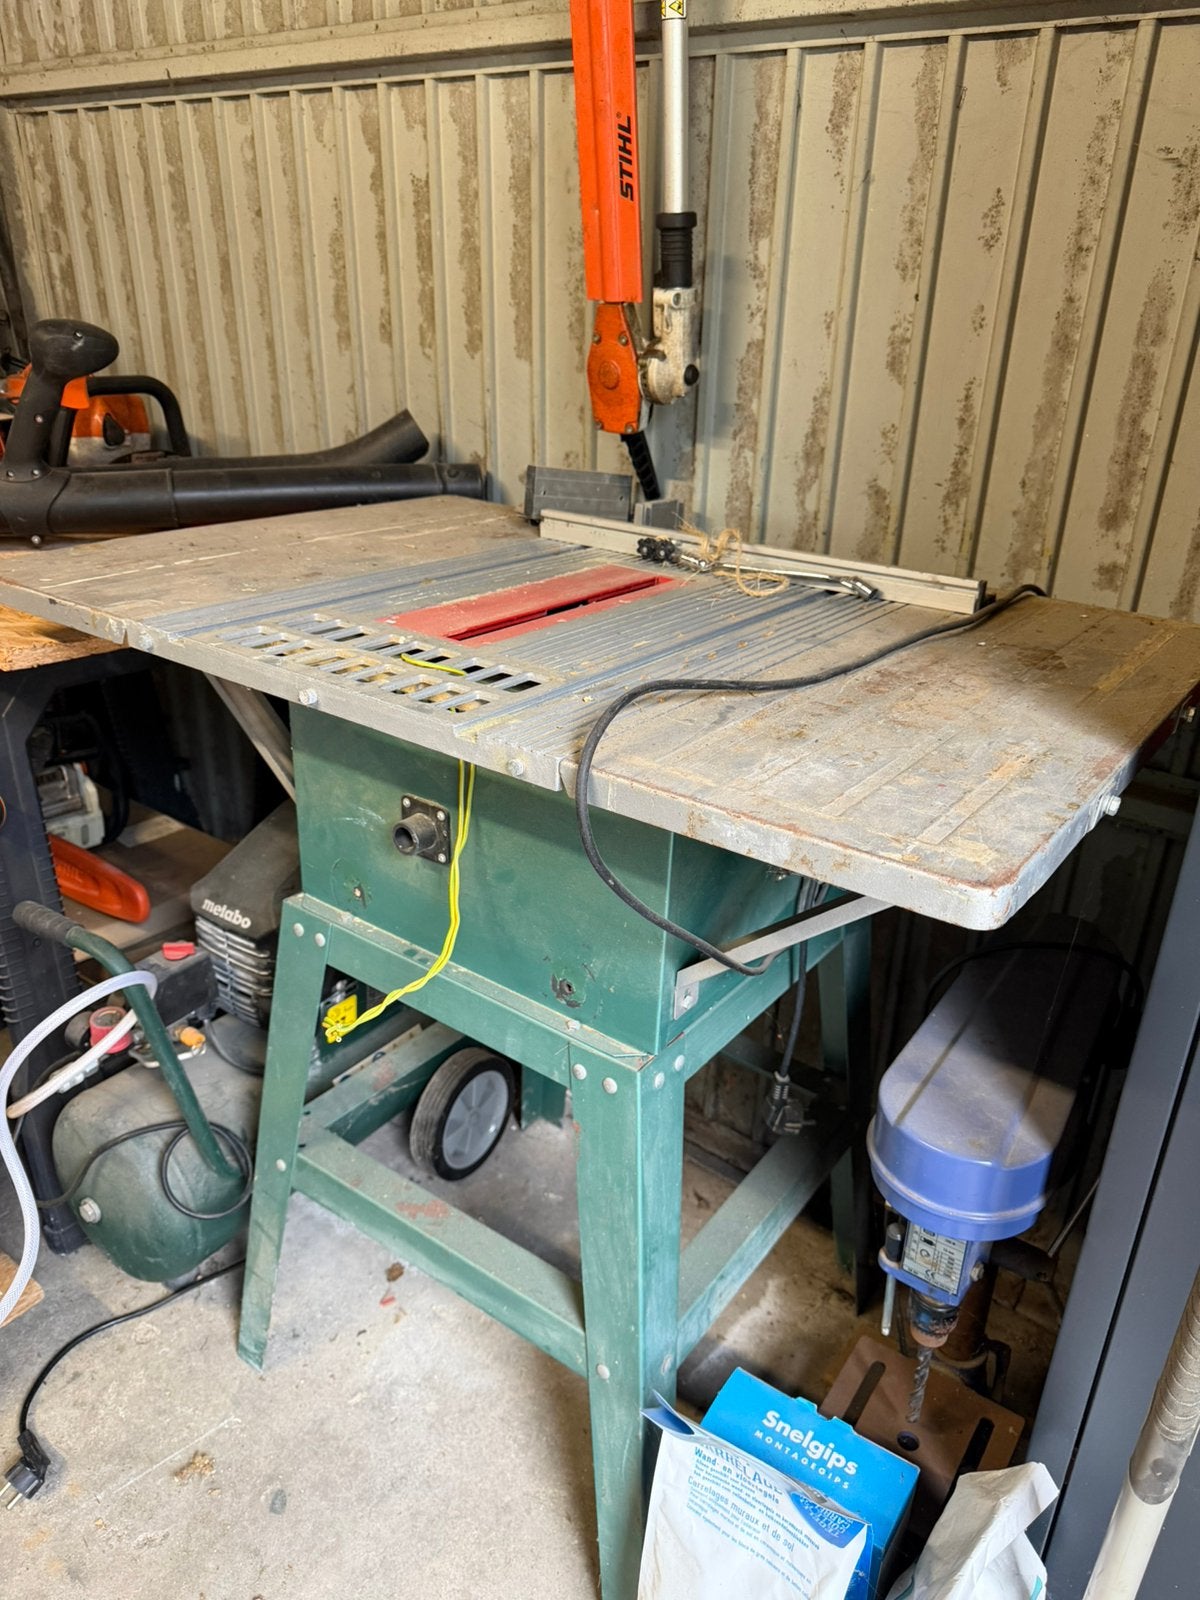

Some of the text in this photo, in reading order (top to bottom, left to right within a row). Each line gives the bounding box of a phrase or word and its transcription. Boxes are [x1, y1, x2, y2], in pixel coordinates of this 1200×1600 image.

[617, 115, 634, 202] STIHL
[202, 898, 252, 928] metabo
[754, 1430, 849, 1489] MONTAGEGIPS
[762, 1410, 858, 1475] Snelgips
[730, 1502, 760, 1526] muraux
[761, 1522, 770, 1533] et
[771, 1529, 781, 1542] de
[783, 1538, 795, 1552] sol
